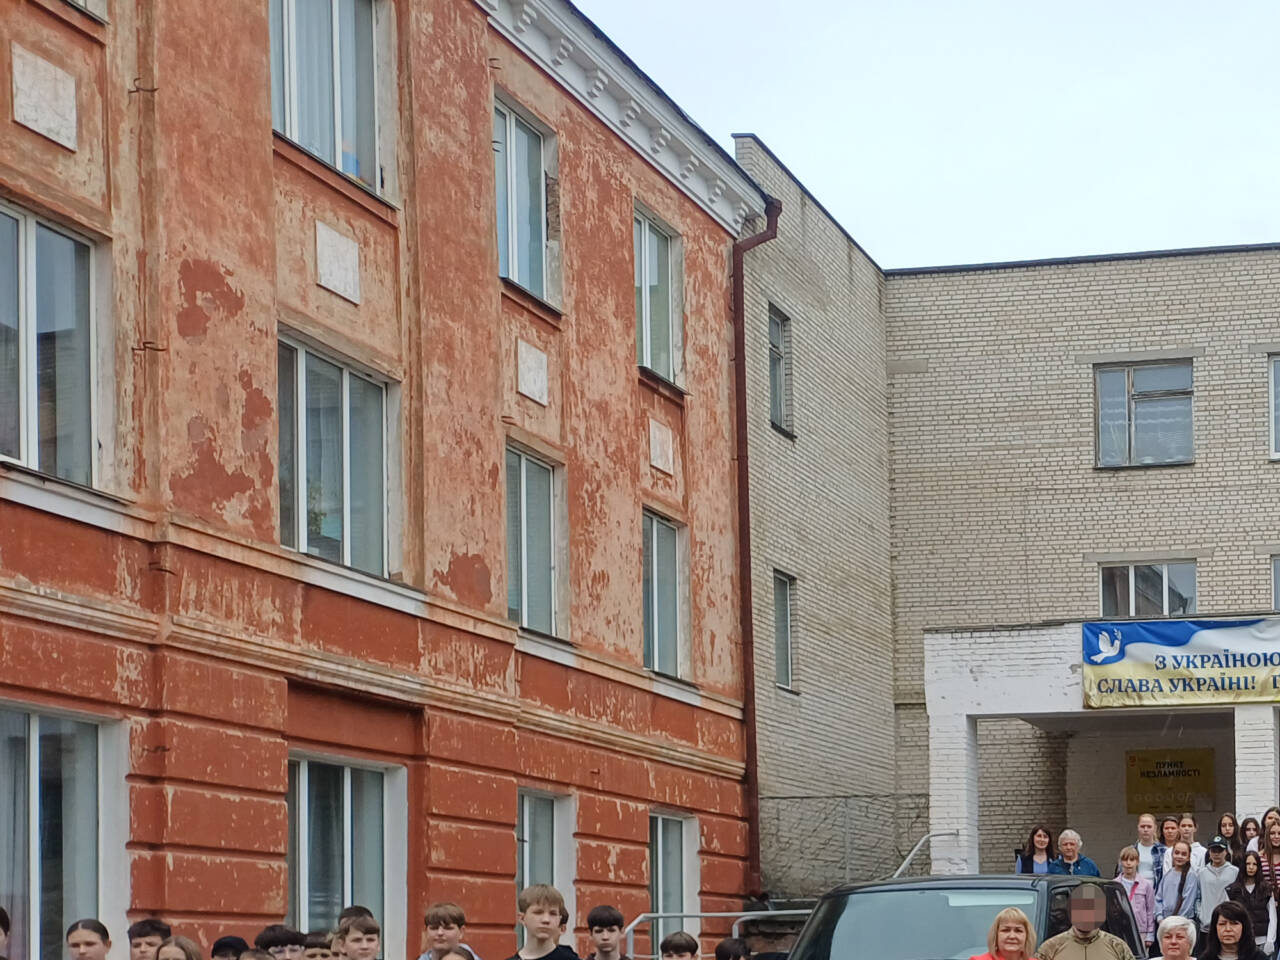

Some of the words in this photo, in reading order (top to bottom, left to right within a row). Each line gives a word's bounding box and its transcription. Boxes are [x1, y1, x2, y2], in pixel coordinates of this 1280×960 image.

[1155, 655, 1167, 670] З
[1097, 677, 1164, 694] СЛАВА
[1168, 673, 1256, 693] УКРАЇНІ!
[1155, 761, 1185, 769] ПУНКТ
[1140, 769, 1200, 778] НЕЗЛАМНОСТІ
